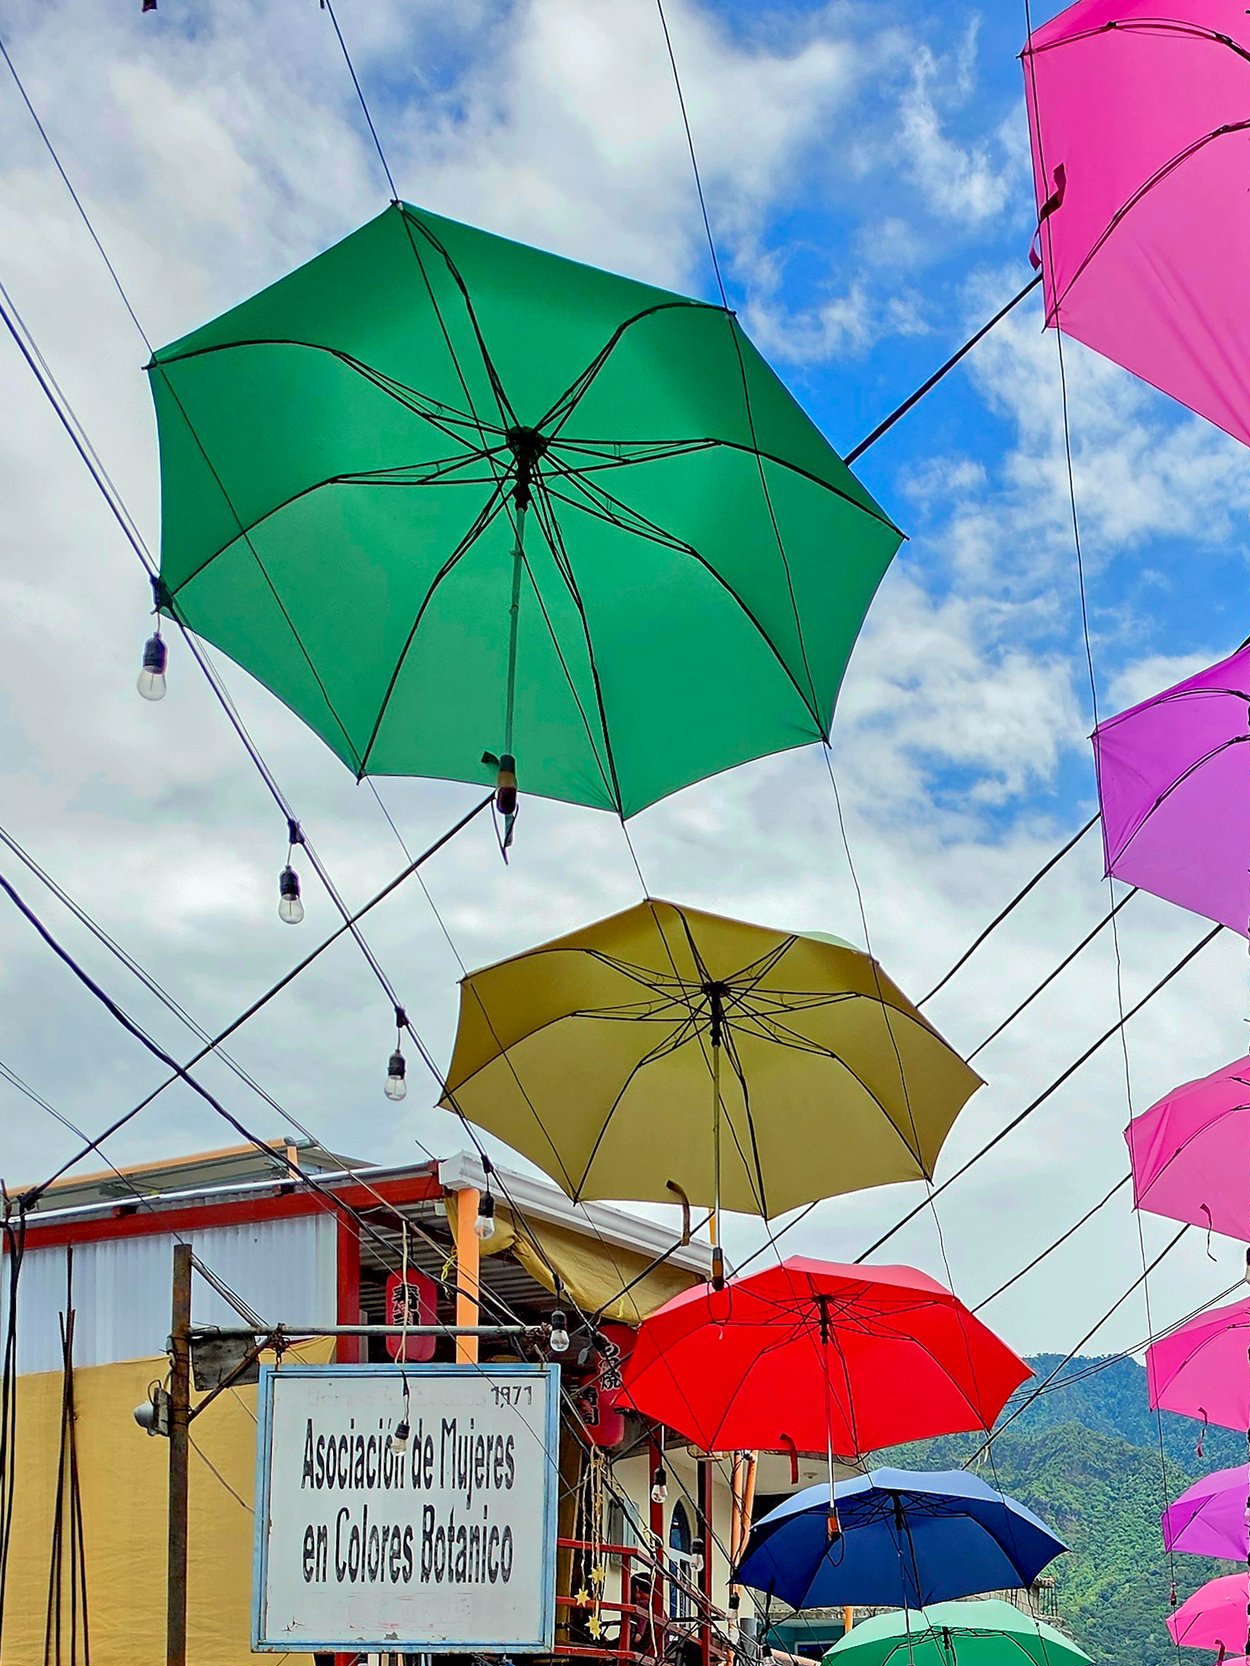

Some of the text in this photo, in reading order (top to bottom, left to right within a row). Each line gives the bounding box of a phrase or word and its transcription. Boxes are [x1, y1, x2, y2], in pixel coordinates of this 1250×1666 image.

[301, 1417, 515, 1510] Asociación de Mujeres
[302, 1504, 514, 1584] en Colores Botanico
